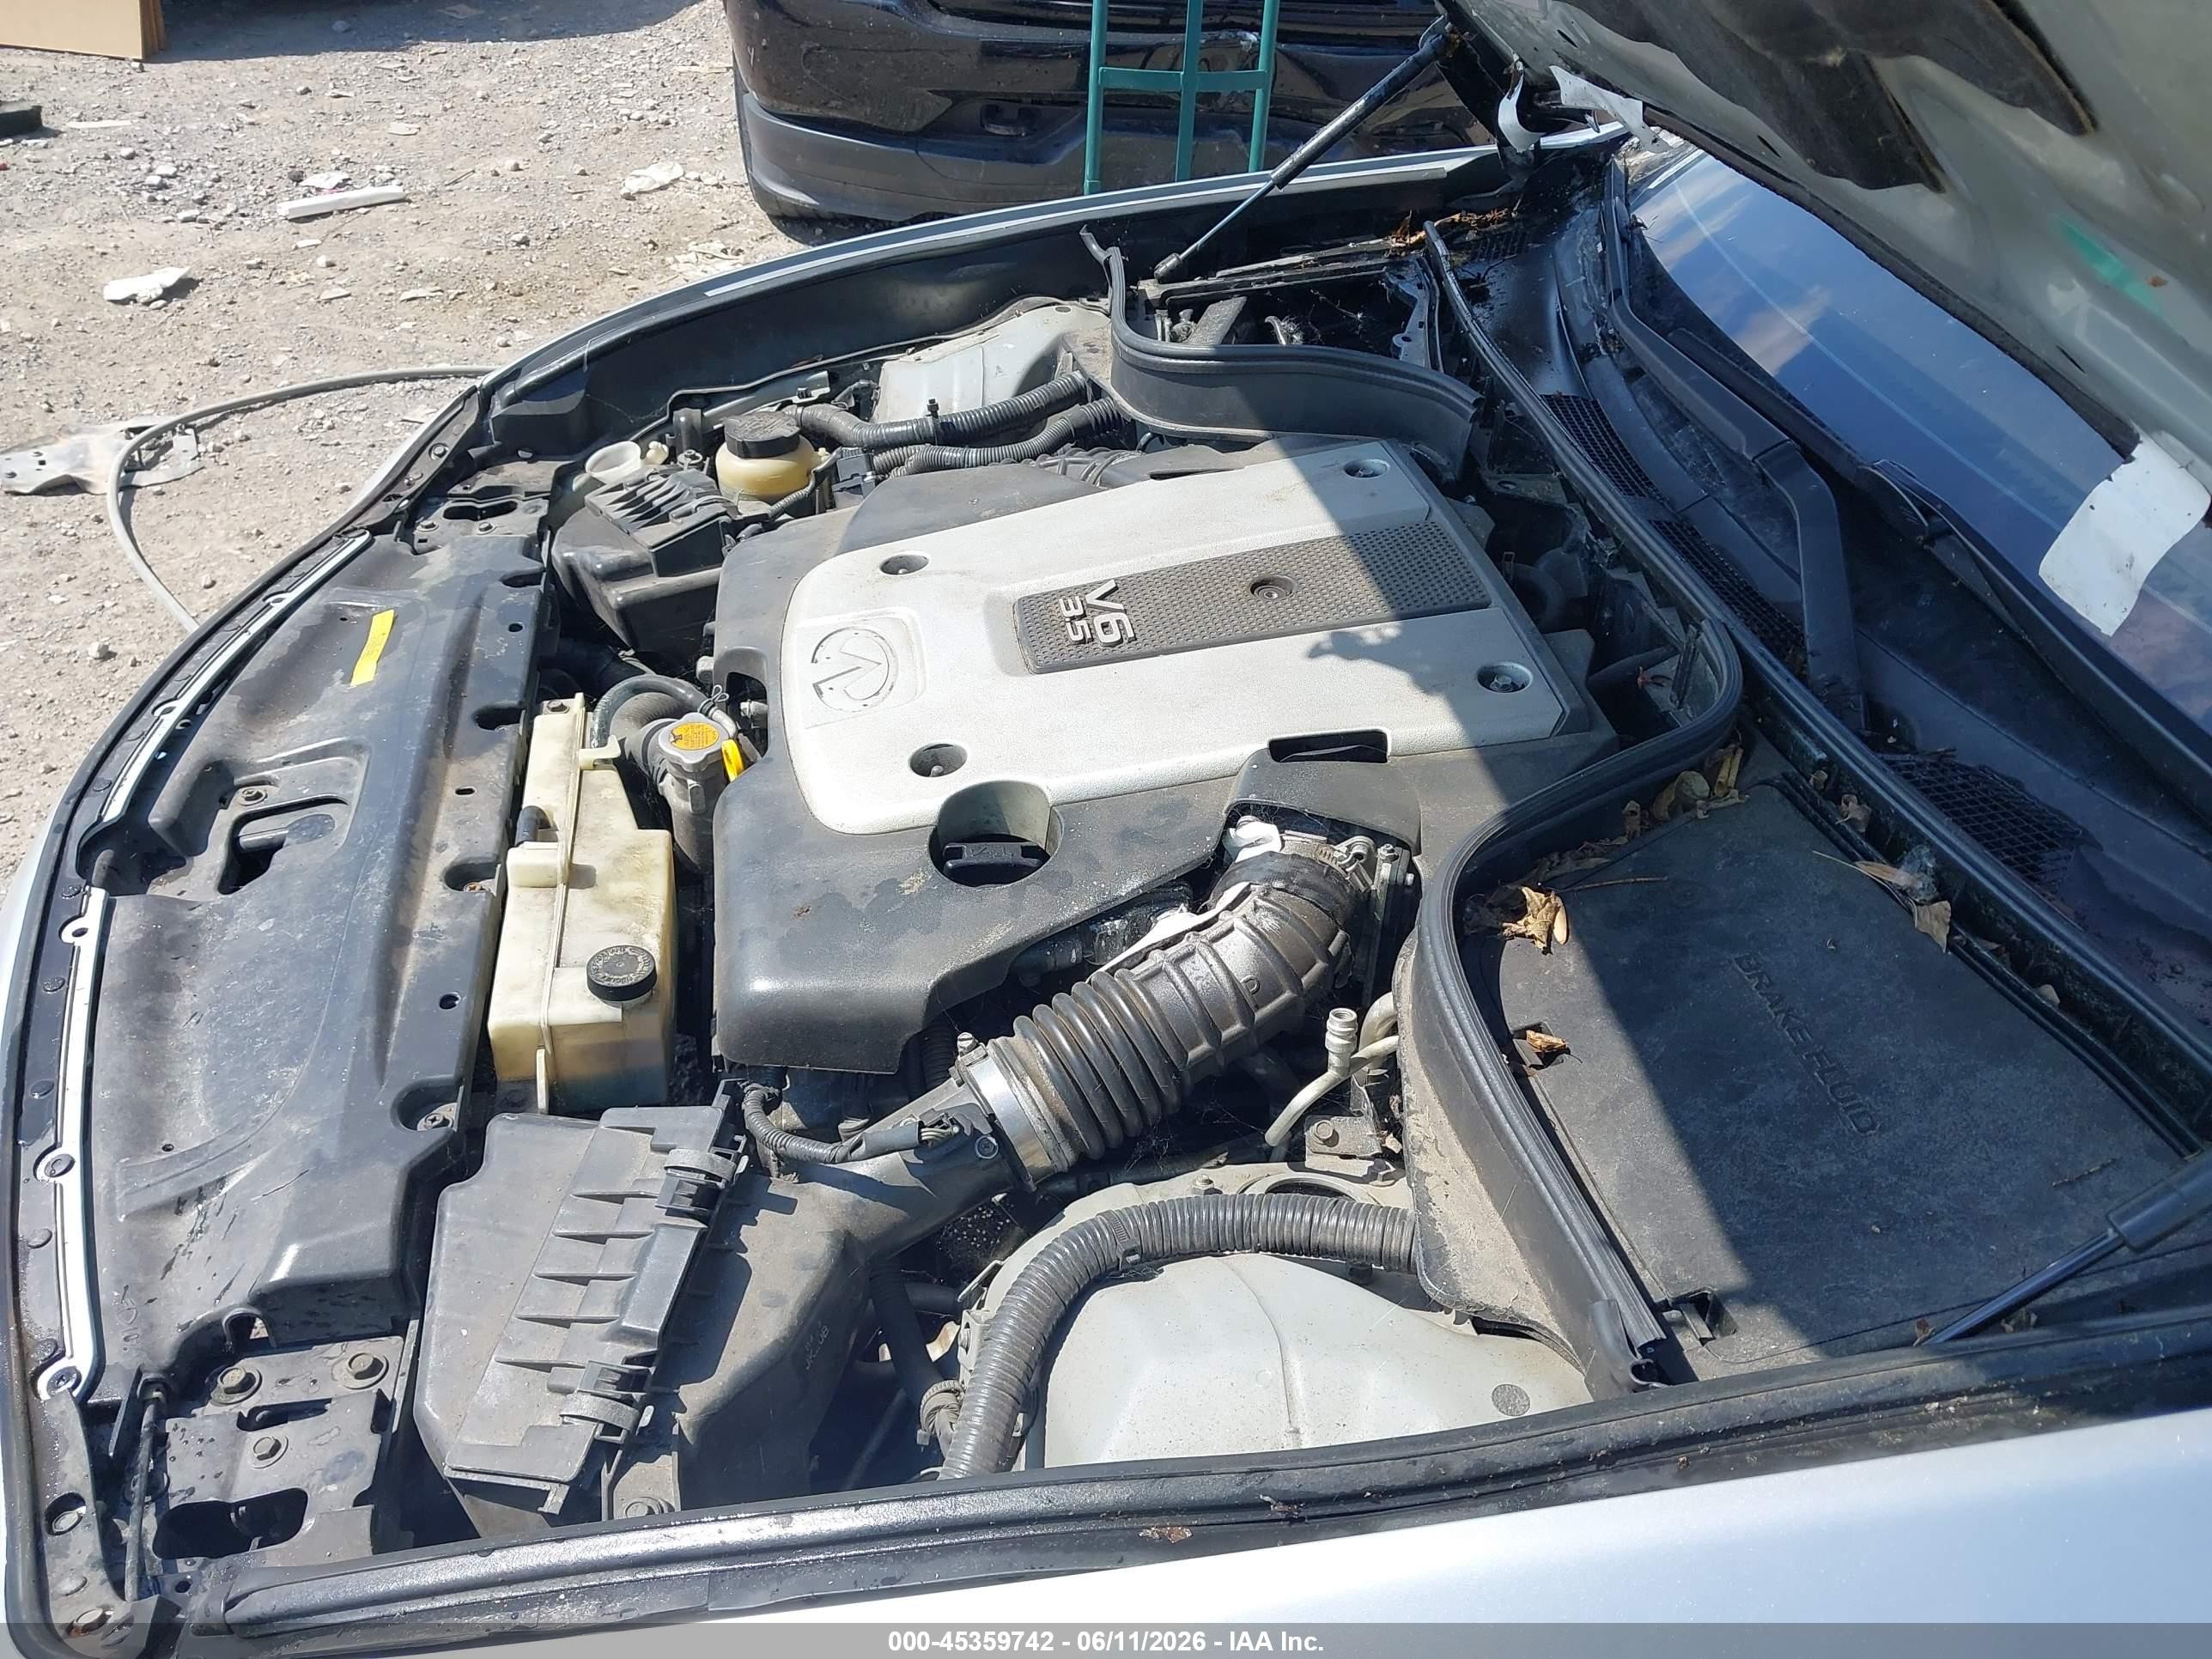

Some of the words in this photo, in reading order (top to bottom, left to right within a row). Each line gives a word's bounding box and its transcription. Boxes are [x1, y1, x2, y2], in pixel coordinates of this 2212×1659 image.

[1058, 595, 1092, 642] 3.5
[1085, 579, 1135, 645] V6
[1731, 954, 1813, 1047] BRAKE
[1802, 1044, 1881, 1134] FLUID
